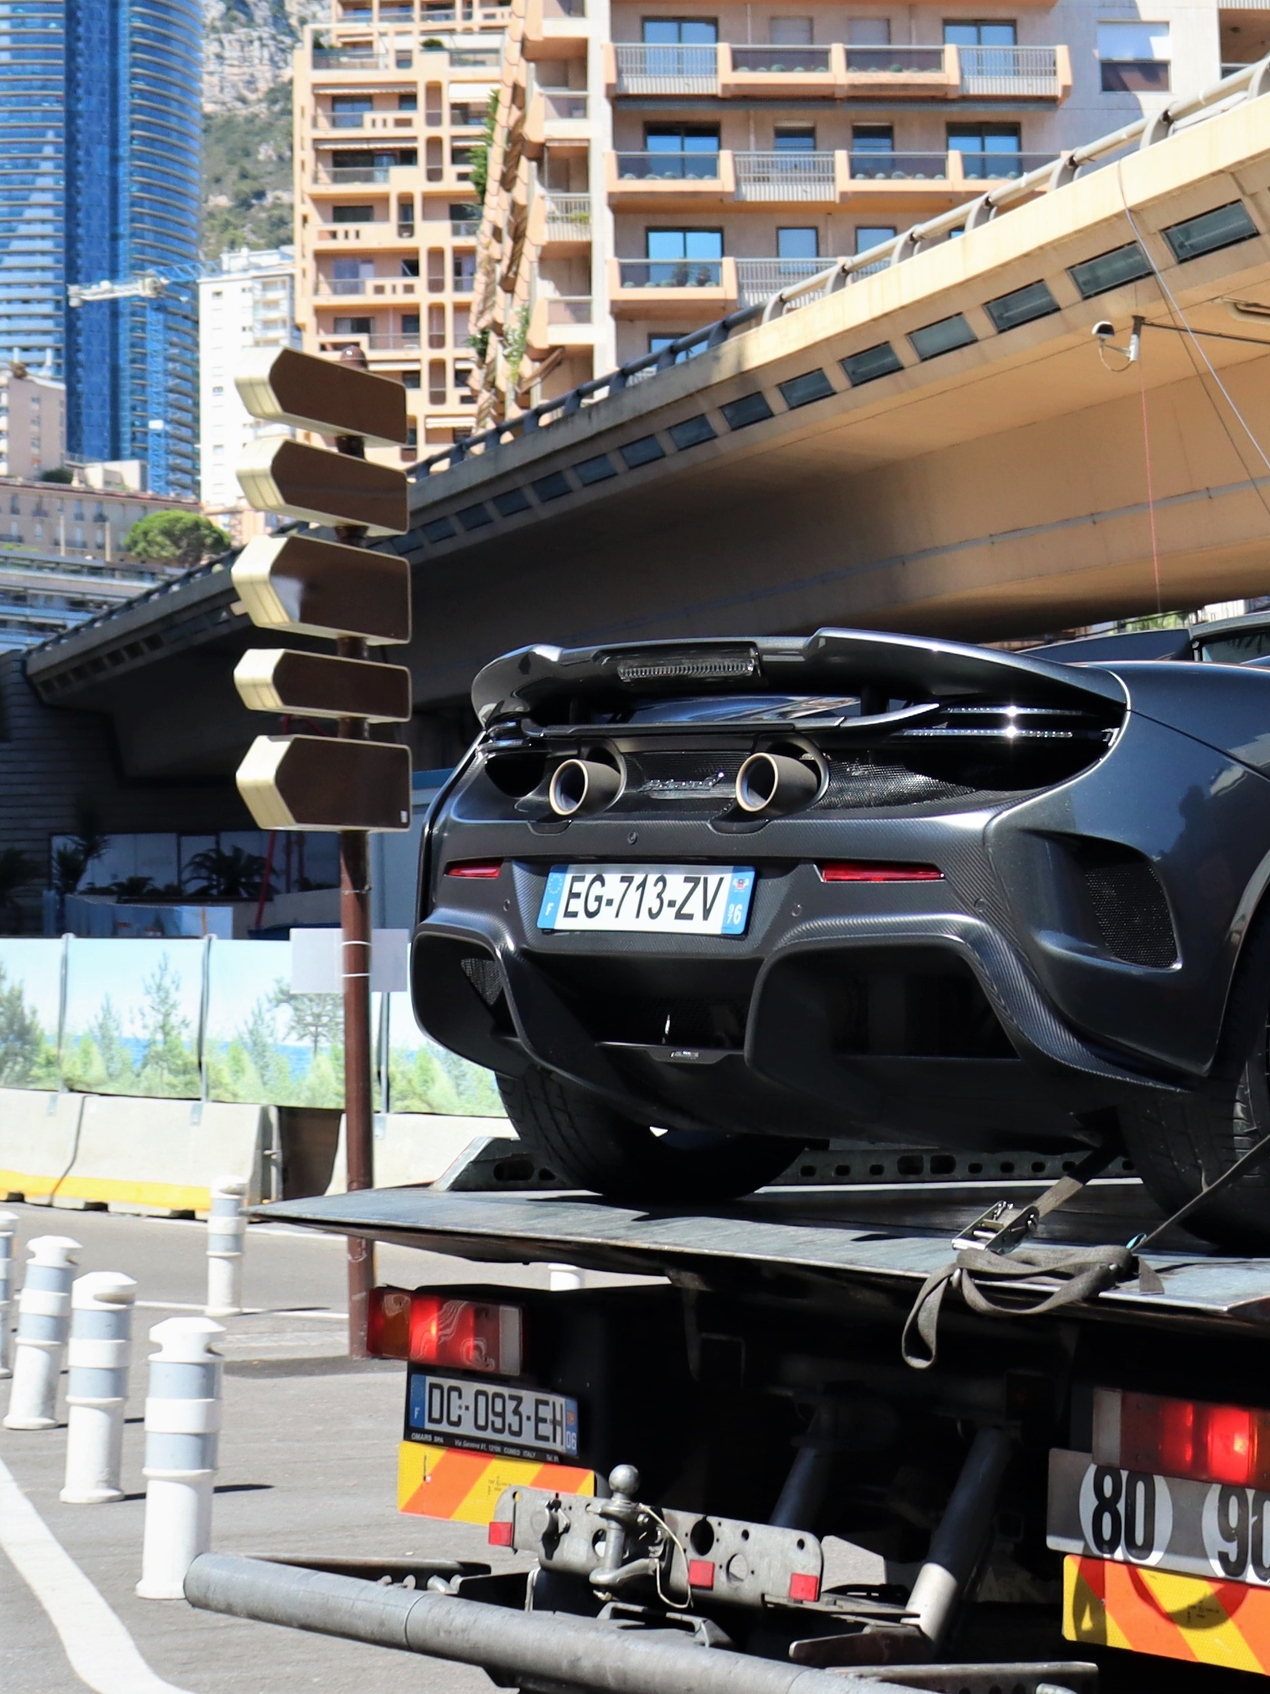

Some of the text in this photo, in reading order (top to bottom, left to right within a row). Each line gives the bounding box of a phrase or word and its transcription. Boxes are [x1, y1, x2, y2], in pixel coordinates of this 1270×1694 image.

[545, 903, 555, 916] F
[562, 873, 725, 922] EG-713-ZV
[428, 1382, 565, 1446] DC-093-EH
[566, 1431, 578, 1450] 06
[1092, 1465, 1156, 1560] 80
